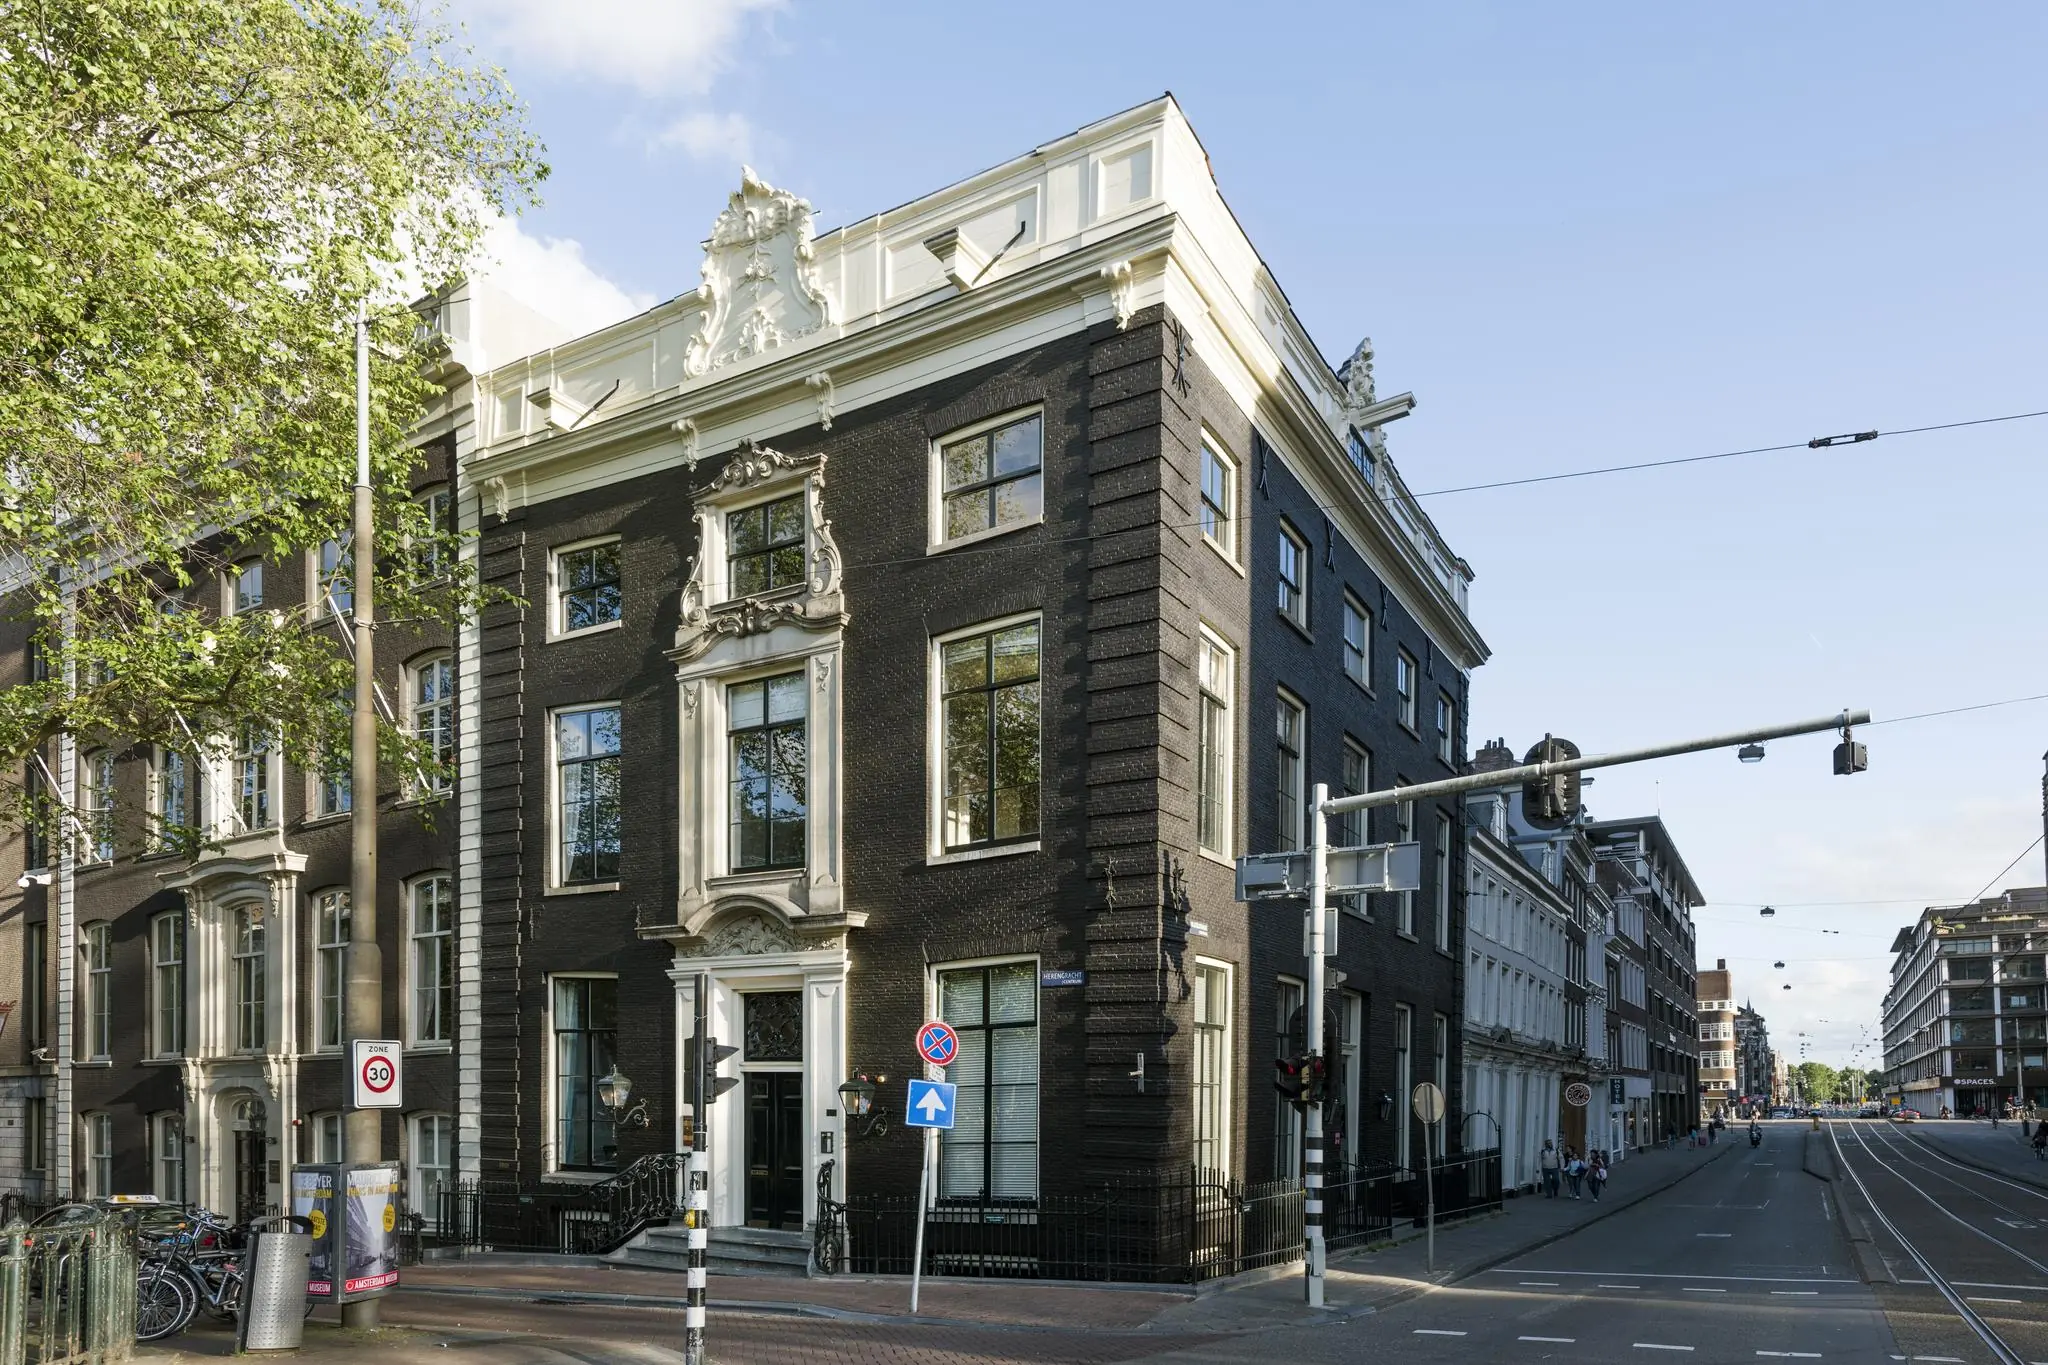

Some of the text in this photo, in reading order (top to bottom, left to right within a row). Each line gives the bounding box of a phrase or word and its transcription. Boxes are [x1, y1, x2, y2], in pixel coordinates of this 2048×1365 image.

[369, 1067, 389, 1081] 30
[309, 1283, 331, 1293] MUSEUM
[354, 1275, 384, 1289] AMSTERDAM
